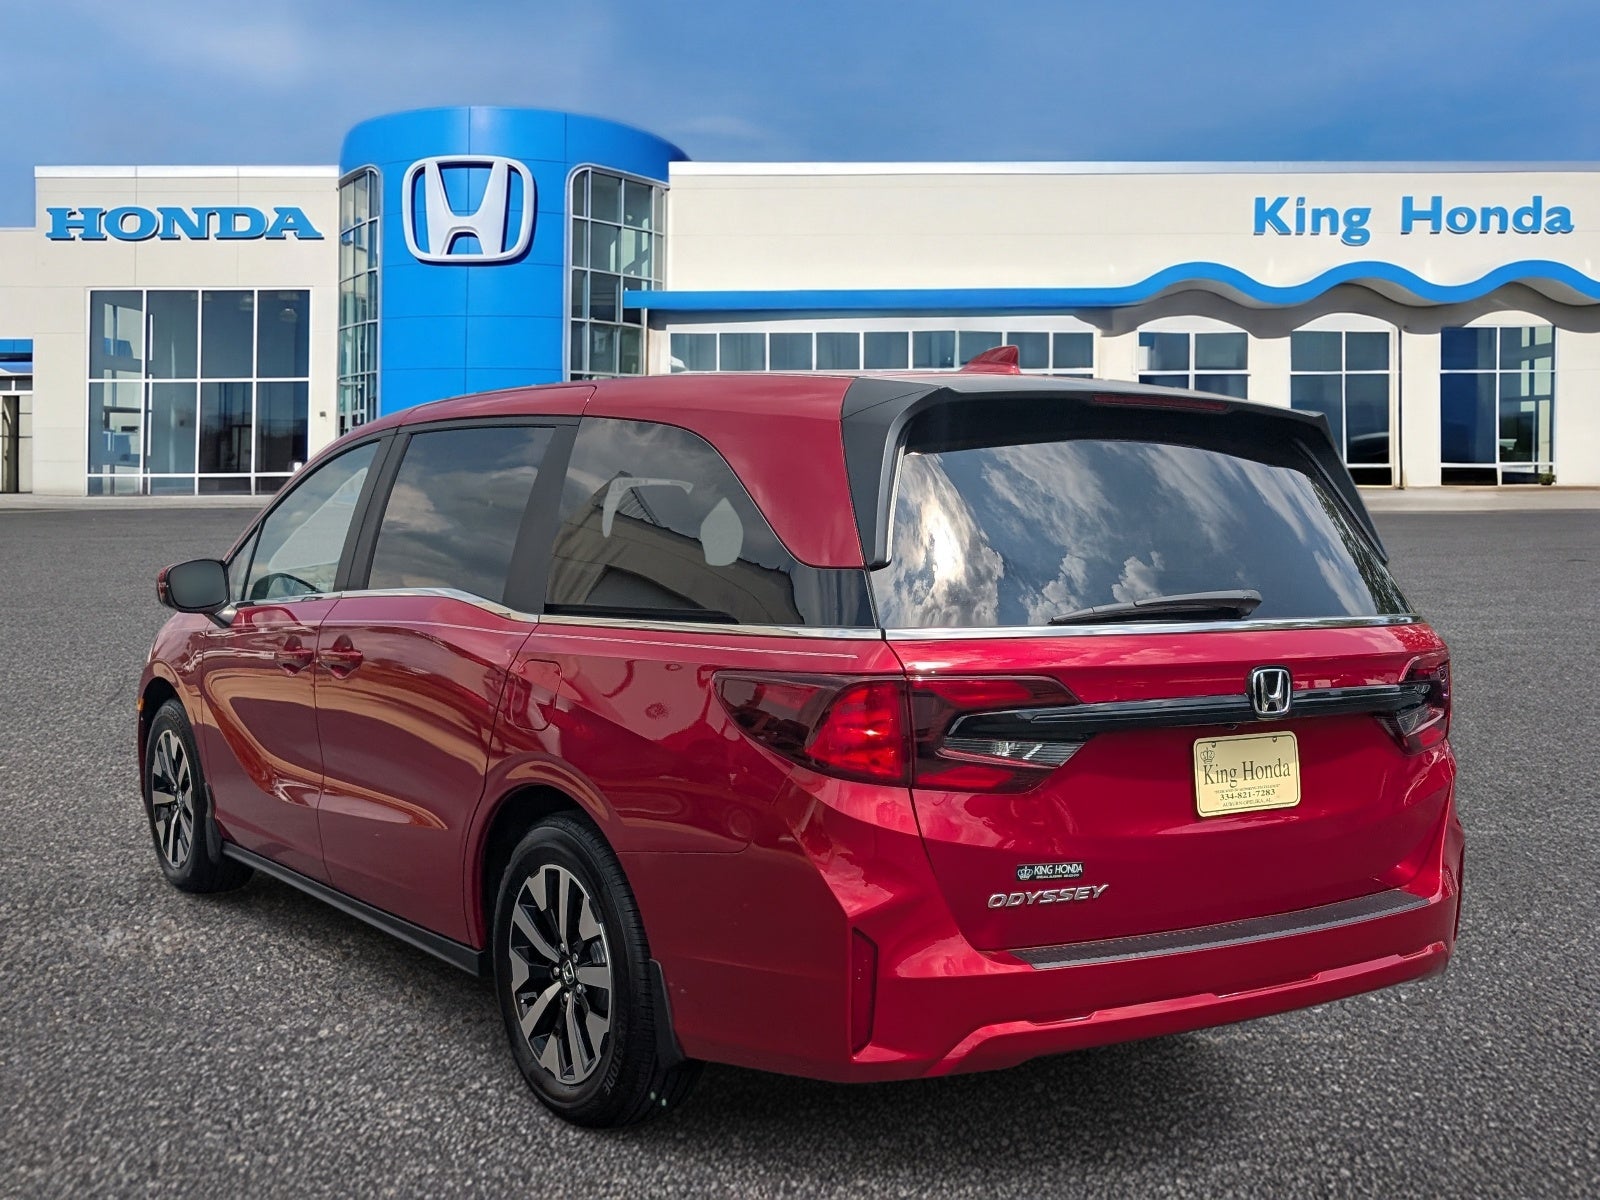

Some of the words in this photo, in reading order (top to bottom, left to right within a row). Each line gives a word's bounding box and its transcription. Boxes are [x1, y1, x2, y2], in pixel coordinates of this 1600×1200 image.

[46, 206, 324, 241] HONDA
[1254, 196, 1371, 246] King
[1400, 195, 1575, 236] Honda
[1203, 763, 1238, 788] King
[1242, 758, 1291, 781] Honda
[1219, 788, 1276, 801] 334-821-7283
[1034, 864, 1053, 875] KING
[1055, 863, 1083, 874] HONDA
[987, 884, 1109, 908] ODYSSEY
